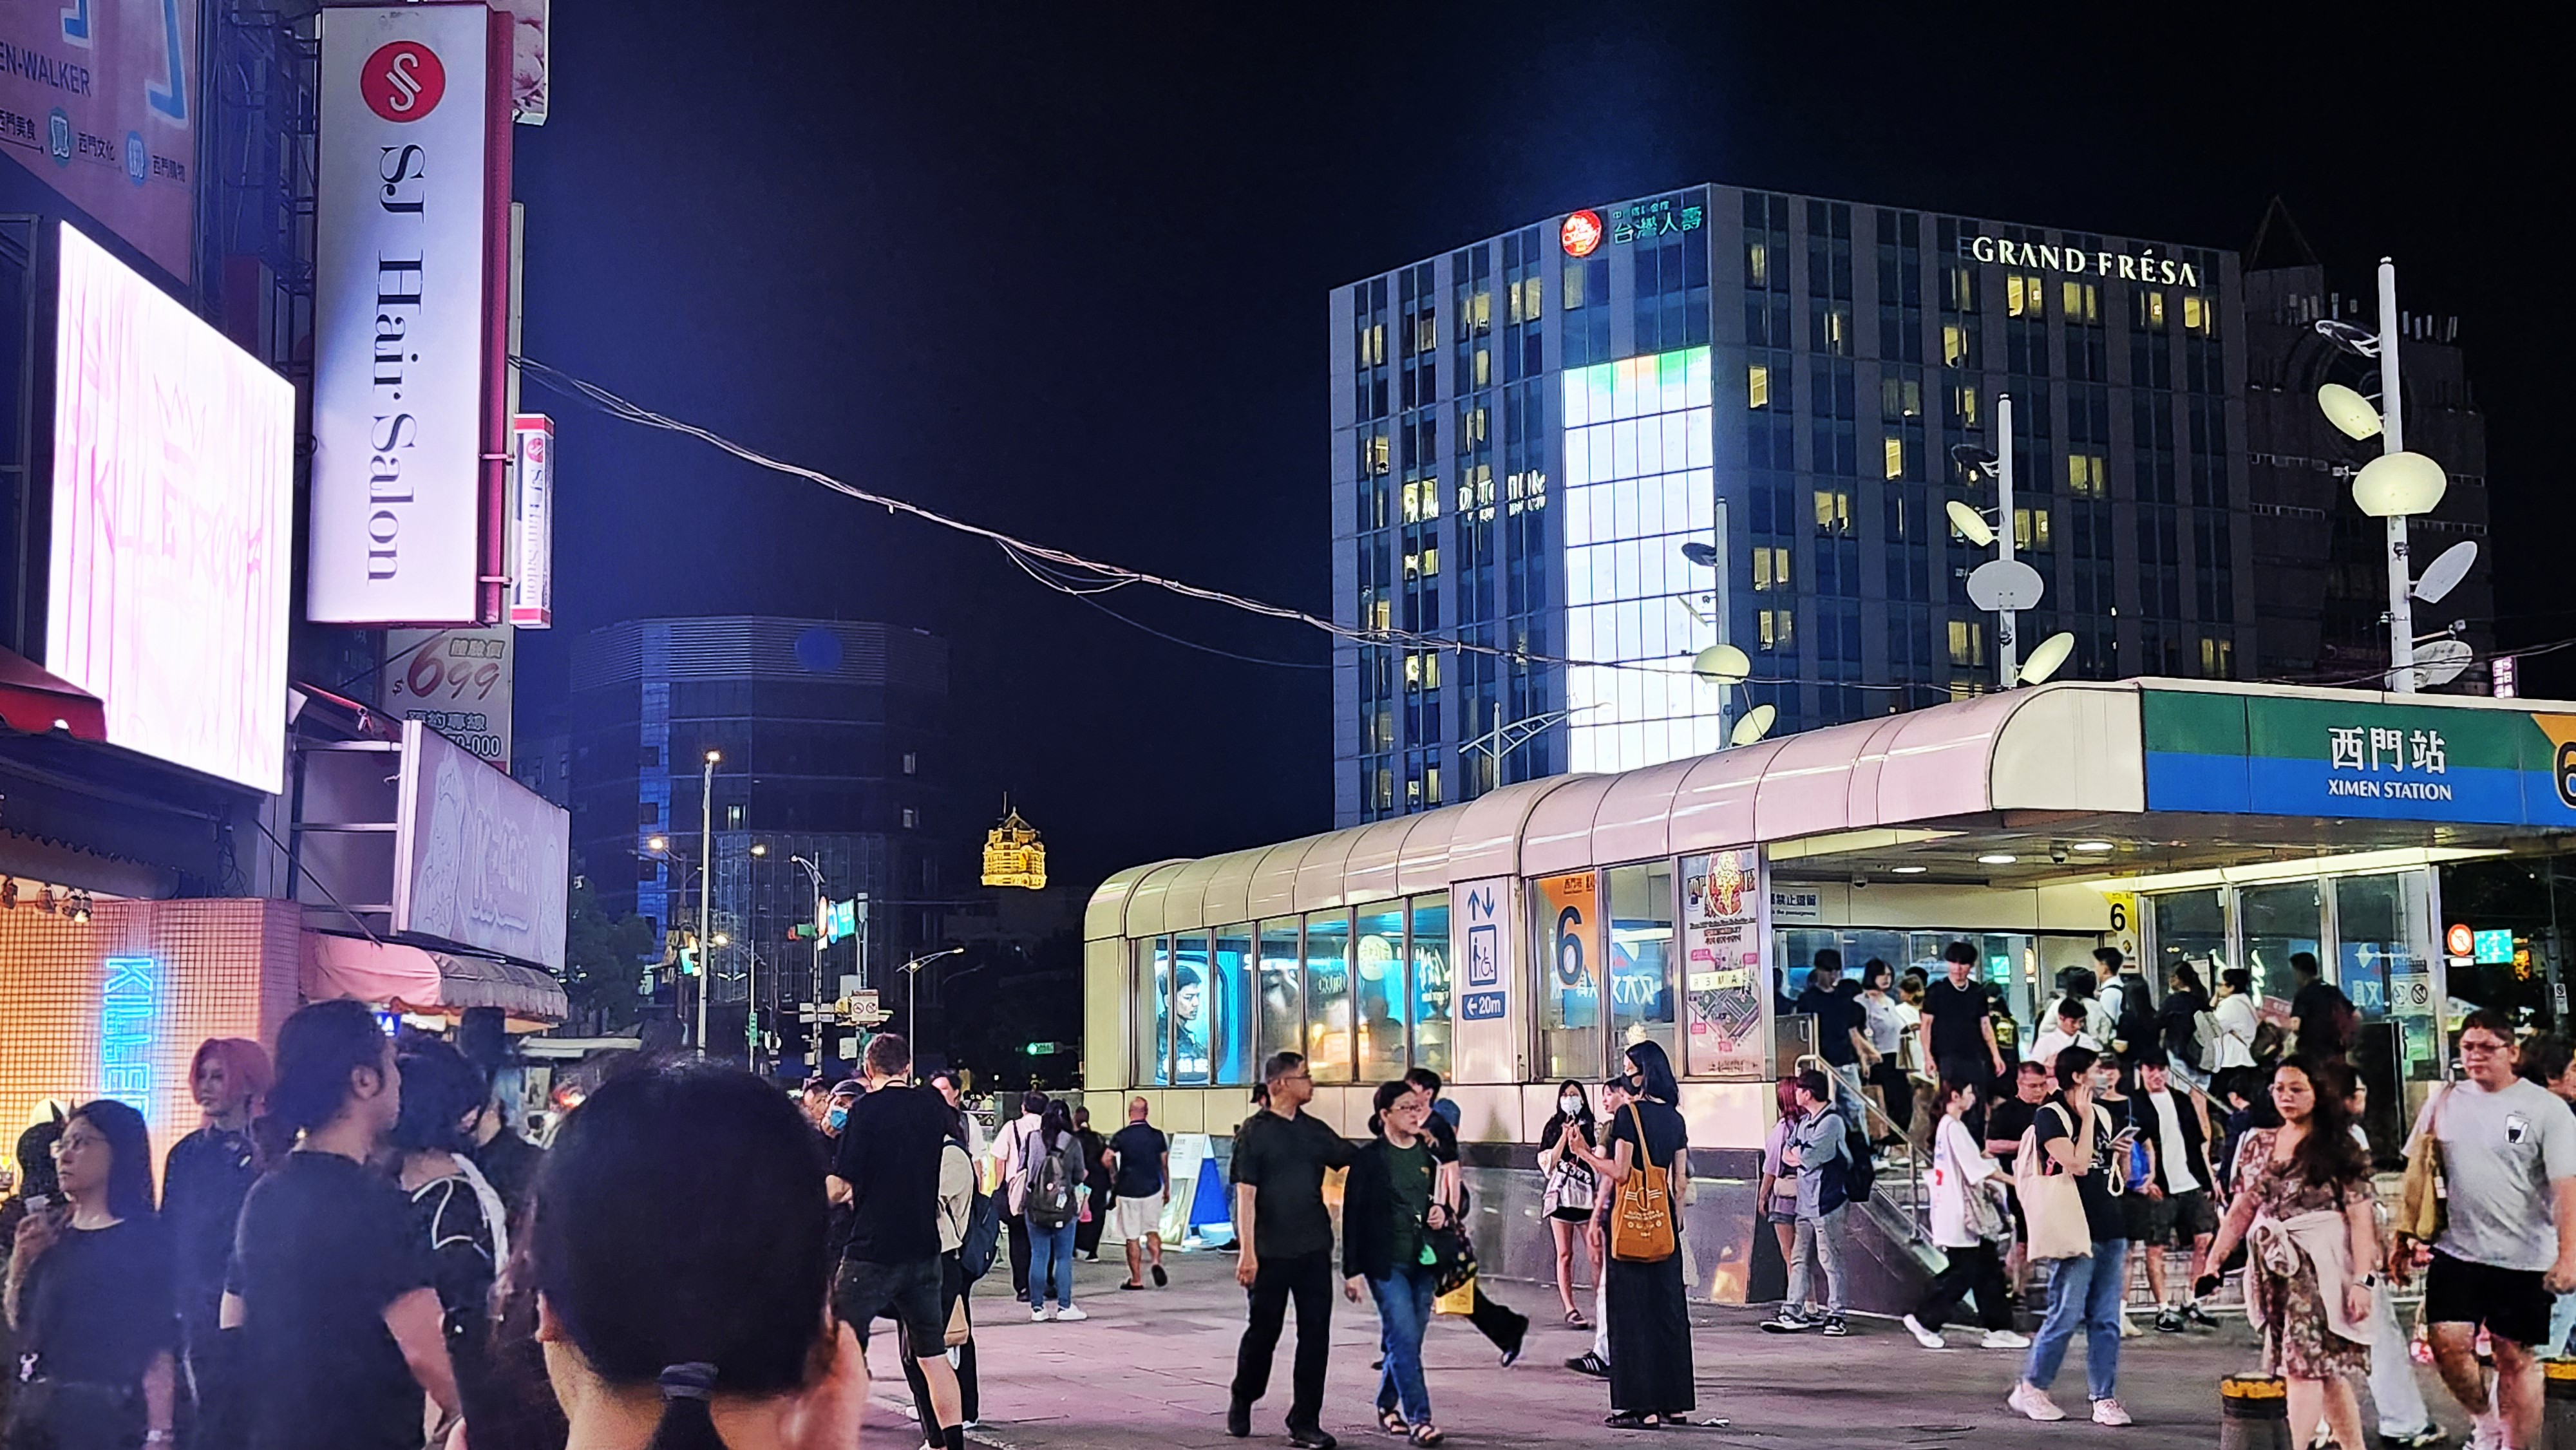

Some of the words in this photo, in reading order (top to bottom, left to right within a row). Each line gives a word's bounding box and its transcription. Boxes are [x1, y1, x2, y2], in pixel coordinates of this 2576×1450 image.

[379, 144, 425, 223] SJ
[1614, 206, 1702, 245] 台灣人壽
[1972, 236, 2086, 274] GRAND
[2098, 249, 2197, 288] FRÉSA
[373, 249, 423, 400] Hair
[367, 413, 417, 586] Salon
[2327, 726, 2446, 775] 西門站
[2328, 779, 2380, 798] XIMEN
[2383, 781, 2452, 800] STATION
[2110, 903, 2126, 932] 6
[1556, 905, 1584, 986] 6
[1479, 995, 1502, 1015] 20m
